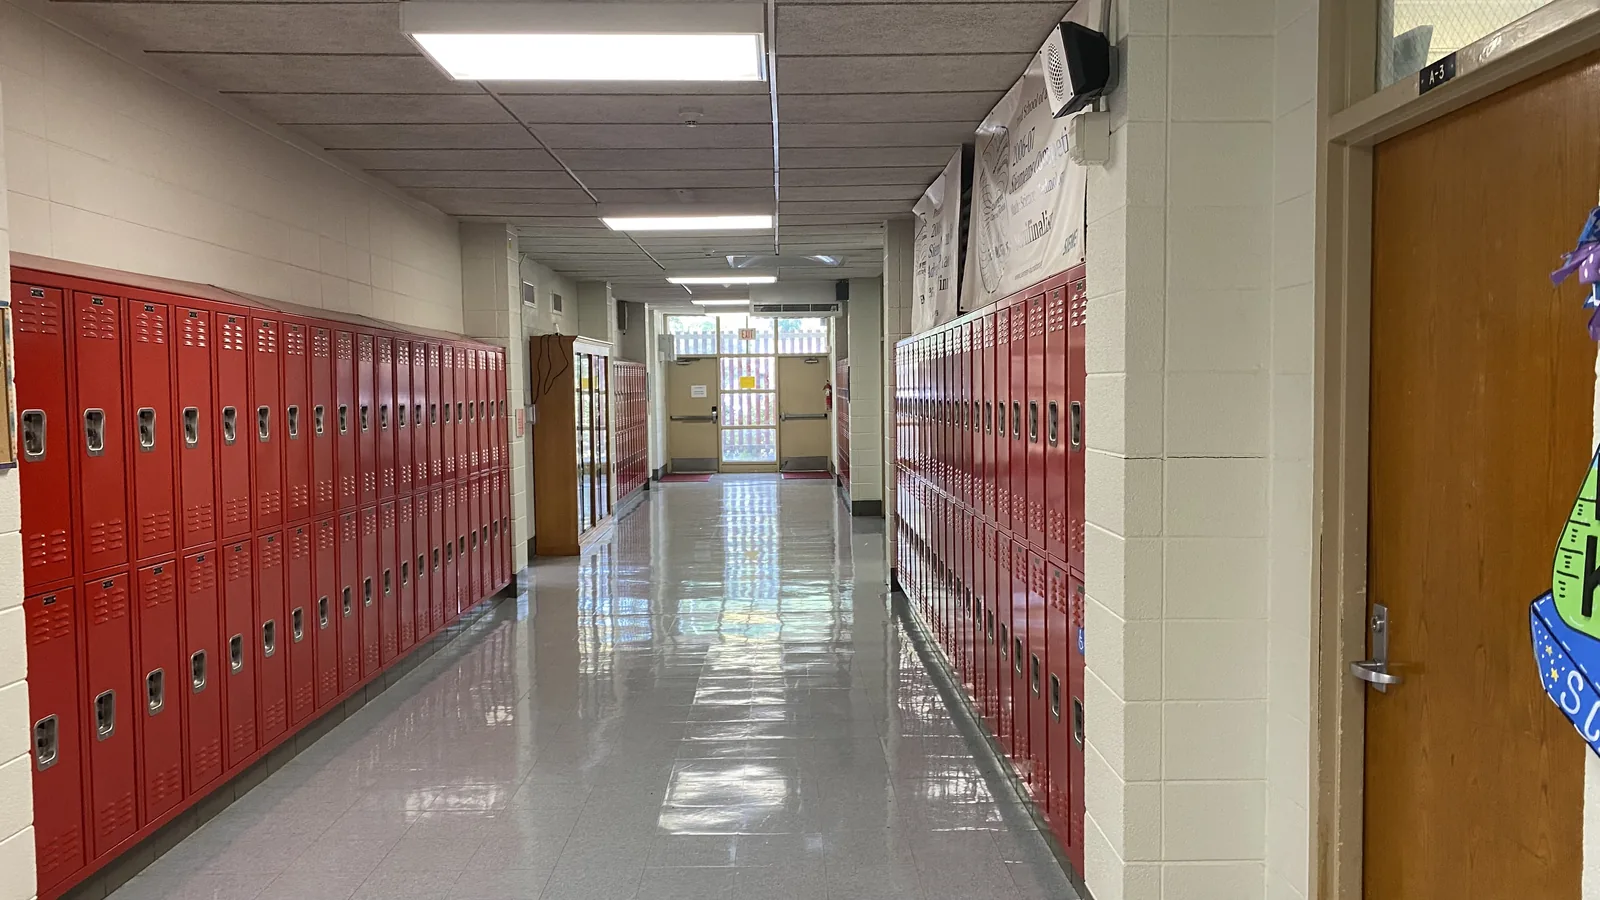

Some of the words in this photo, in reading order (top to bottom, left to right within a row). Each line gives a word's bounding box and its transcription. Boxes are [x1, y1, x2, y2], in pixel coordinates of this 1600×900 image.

[1428, 64, 1445, 85] A-3
[1012, 126, 1036, 167] 2006-07
[741, 329, 753, 339] EXIT
